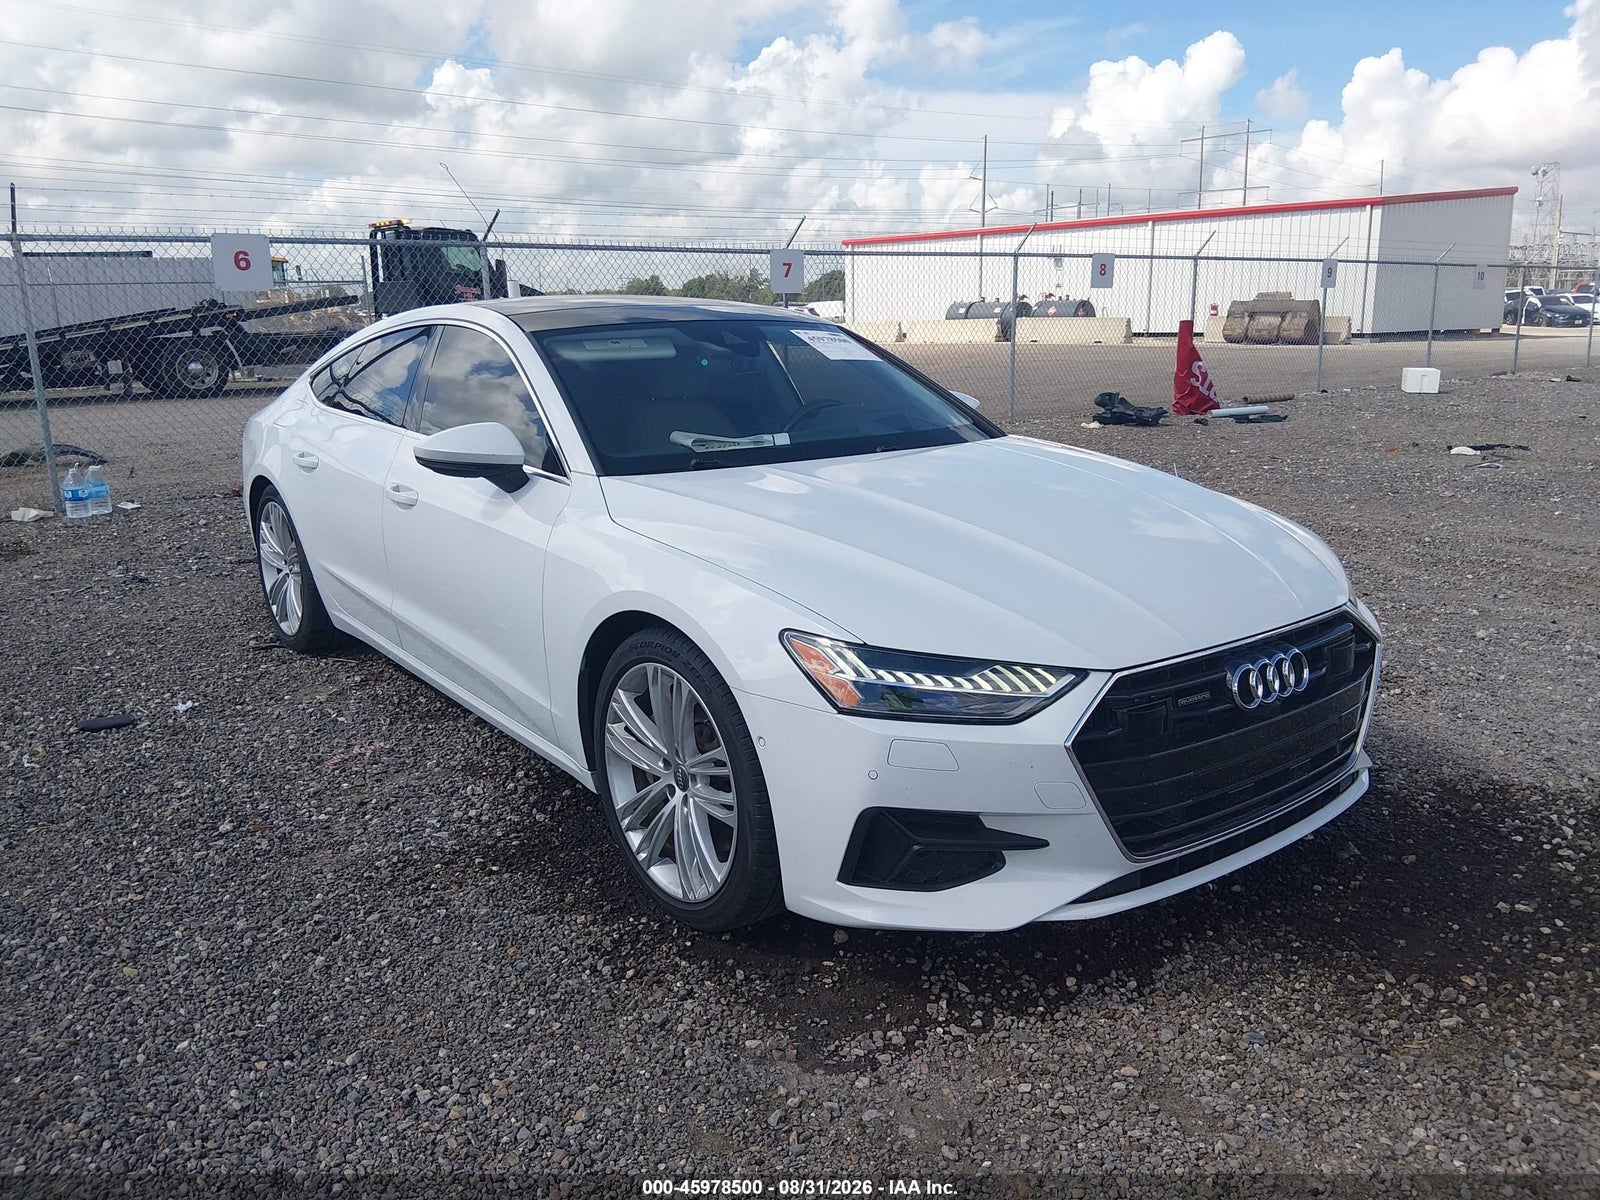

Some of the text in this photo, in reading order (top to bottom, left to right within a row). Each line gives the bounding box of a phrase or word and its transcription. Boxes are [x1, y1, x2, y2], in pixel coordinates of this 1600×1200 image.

[233, 250, 251, 271] 6
[782, 262, 793, 278] 7
[1099, 263, 1107, 276] 8
[1327, 267, 1333, 278] 9
[1477, 271, 1485, 281] 10
